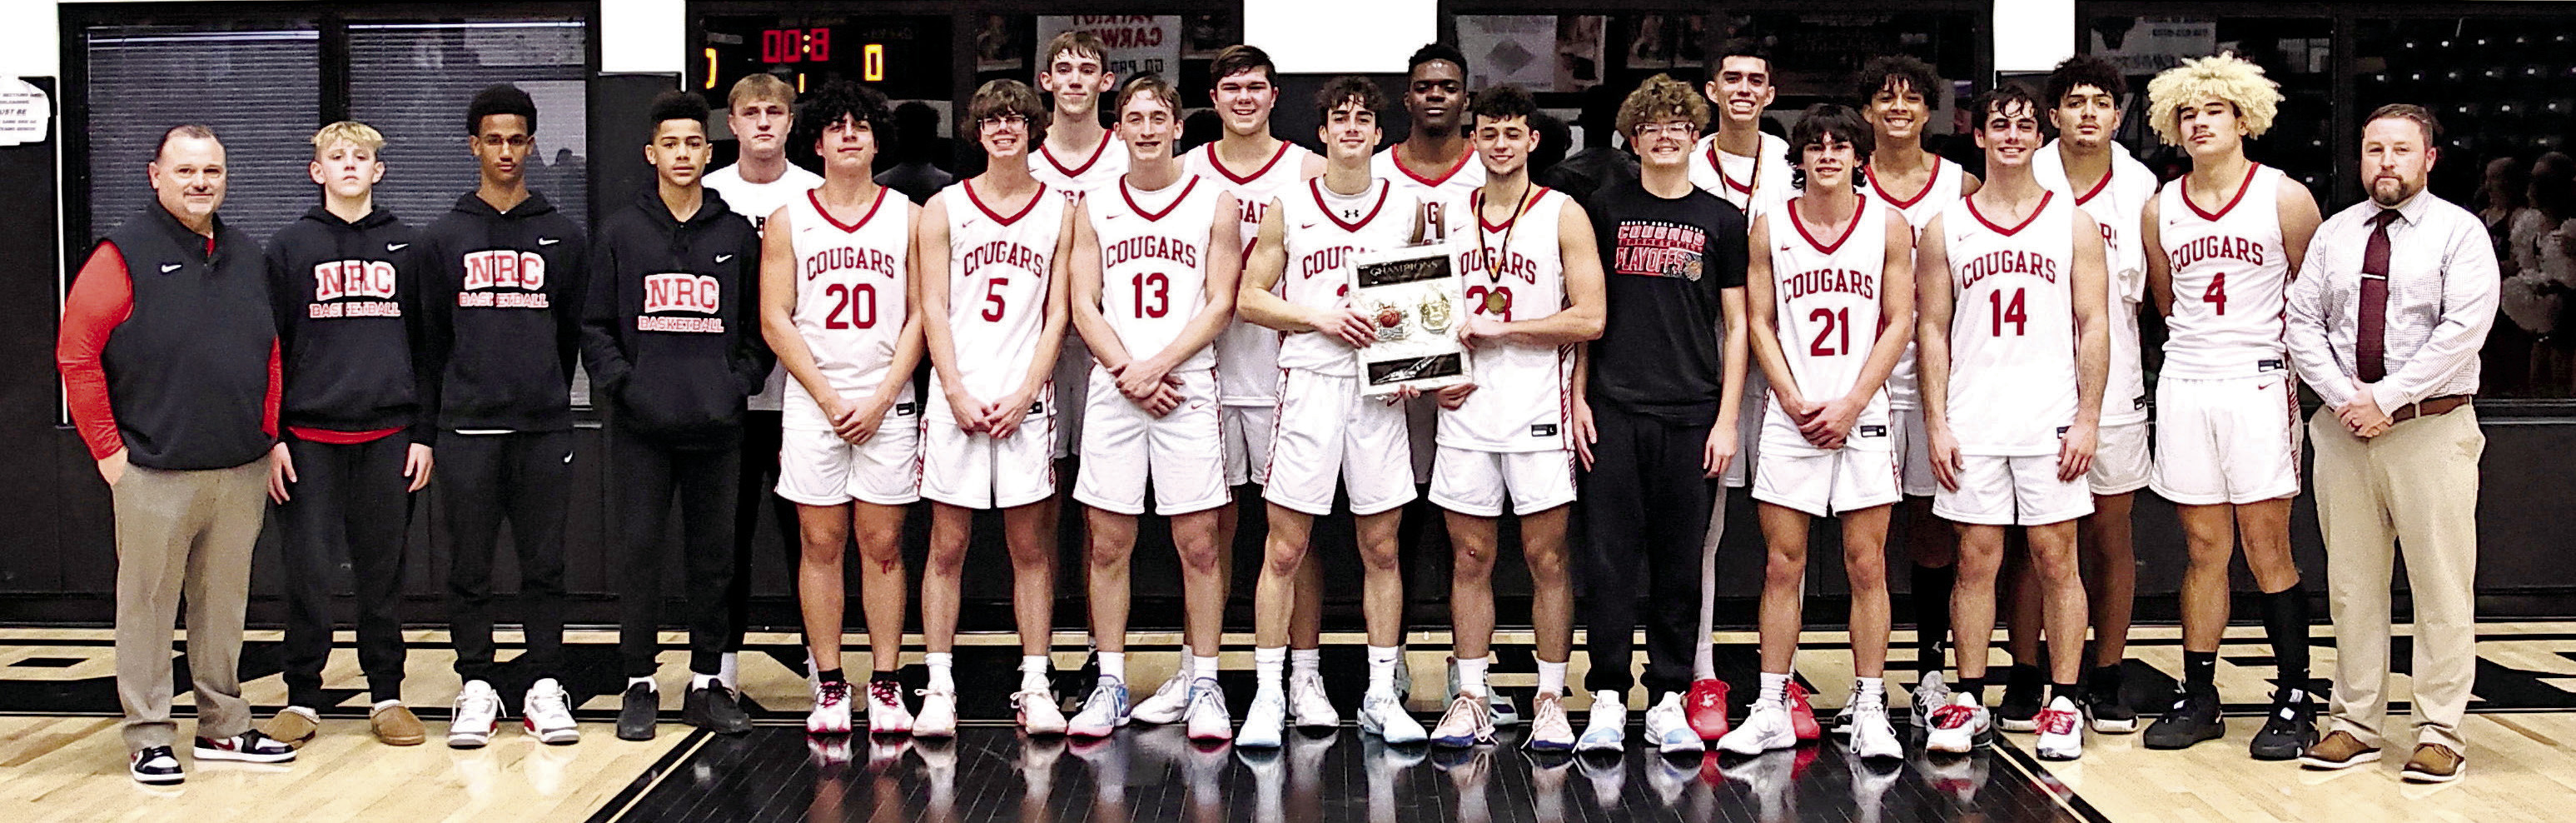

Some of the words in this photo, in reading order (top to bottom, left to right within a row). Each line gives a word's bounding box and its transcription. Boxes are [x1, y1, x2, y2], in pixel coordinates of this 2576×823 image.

[1106, 236, 1196, 269] COUGARS
[1618, 225, 1705, 246] COUGARS
[2172, 236, 2264, 272] COUGARS
[465, 251, 545, 291] NRC
[807, 247, 894, 281] COUGARS
[964, 241, 1043, 278] COUGARS
[1460, 247, 1537, 285] OUGARS
[1614, 247, 1685, 273] PLAYOFFS
[1962, 250, 2056, 290] COUGARS
[315, 261, 395, 301] NRC
[644, 273, 719, 314] NRC
[982, 277, 1009, 322] 5
[1132, 272, 1169, 318] 13
[1783, 268, 1873, 304] COUGARS
[2203, 272, 2227, 316] 4
[638, 316, 724, 332] BASKETBALL
[826, 283, 877, 329] 20
[1990, 287, 2027, 337] 14
[1809, 307, 1849, 356] 21
